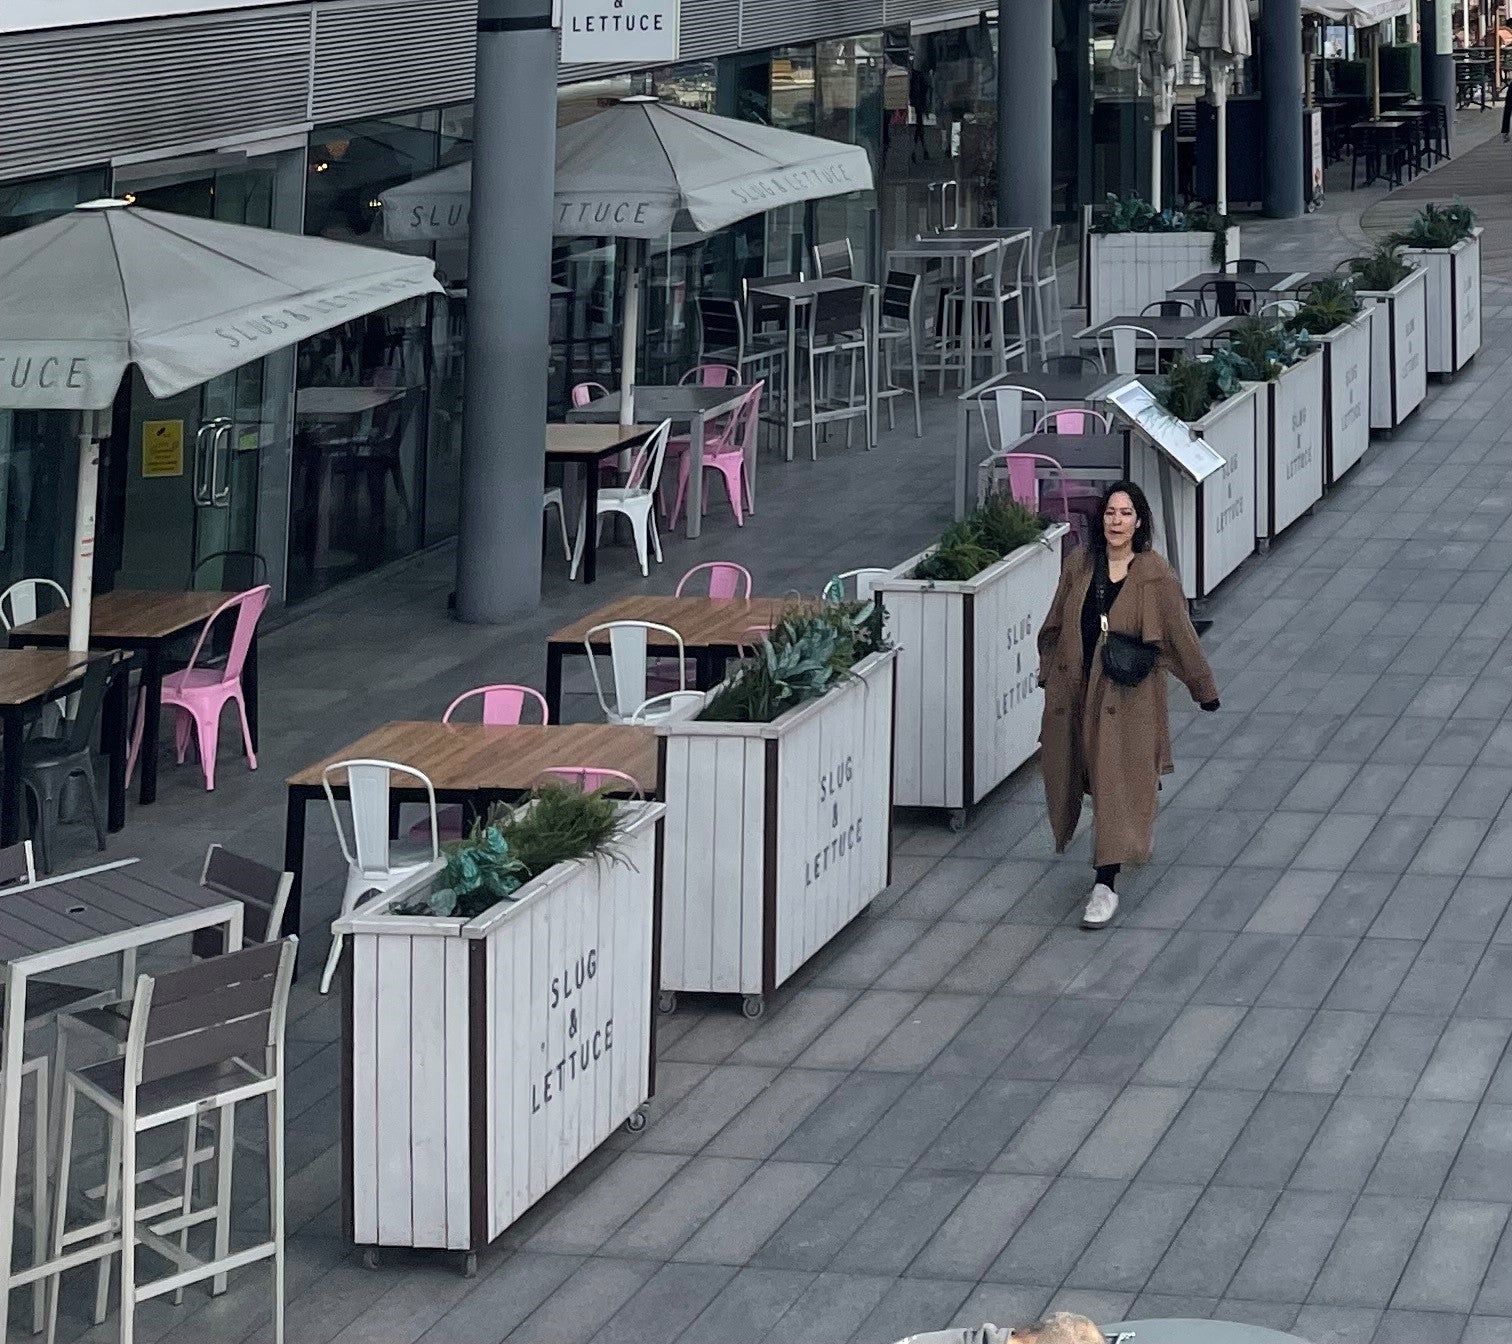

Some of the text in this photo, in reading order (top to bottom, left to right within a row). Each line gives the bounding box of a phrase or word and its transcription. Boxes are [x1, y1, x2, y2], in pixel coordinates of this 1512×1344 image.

[572, 14, 663, 32] LETTUCE
[0, 357, 87, 389] UCE
[820, 756, 852, 803] SLUG
[805, 817, 863, 887] LETTUCE
[550, 948, 597, 1009] SLUG
[568, 1007, 578, 1039] &
[531, 1018, 614, 1115] LETTUCE
